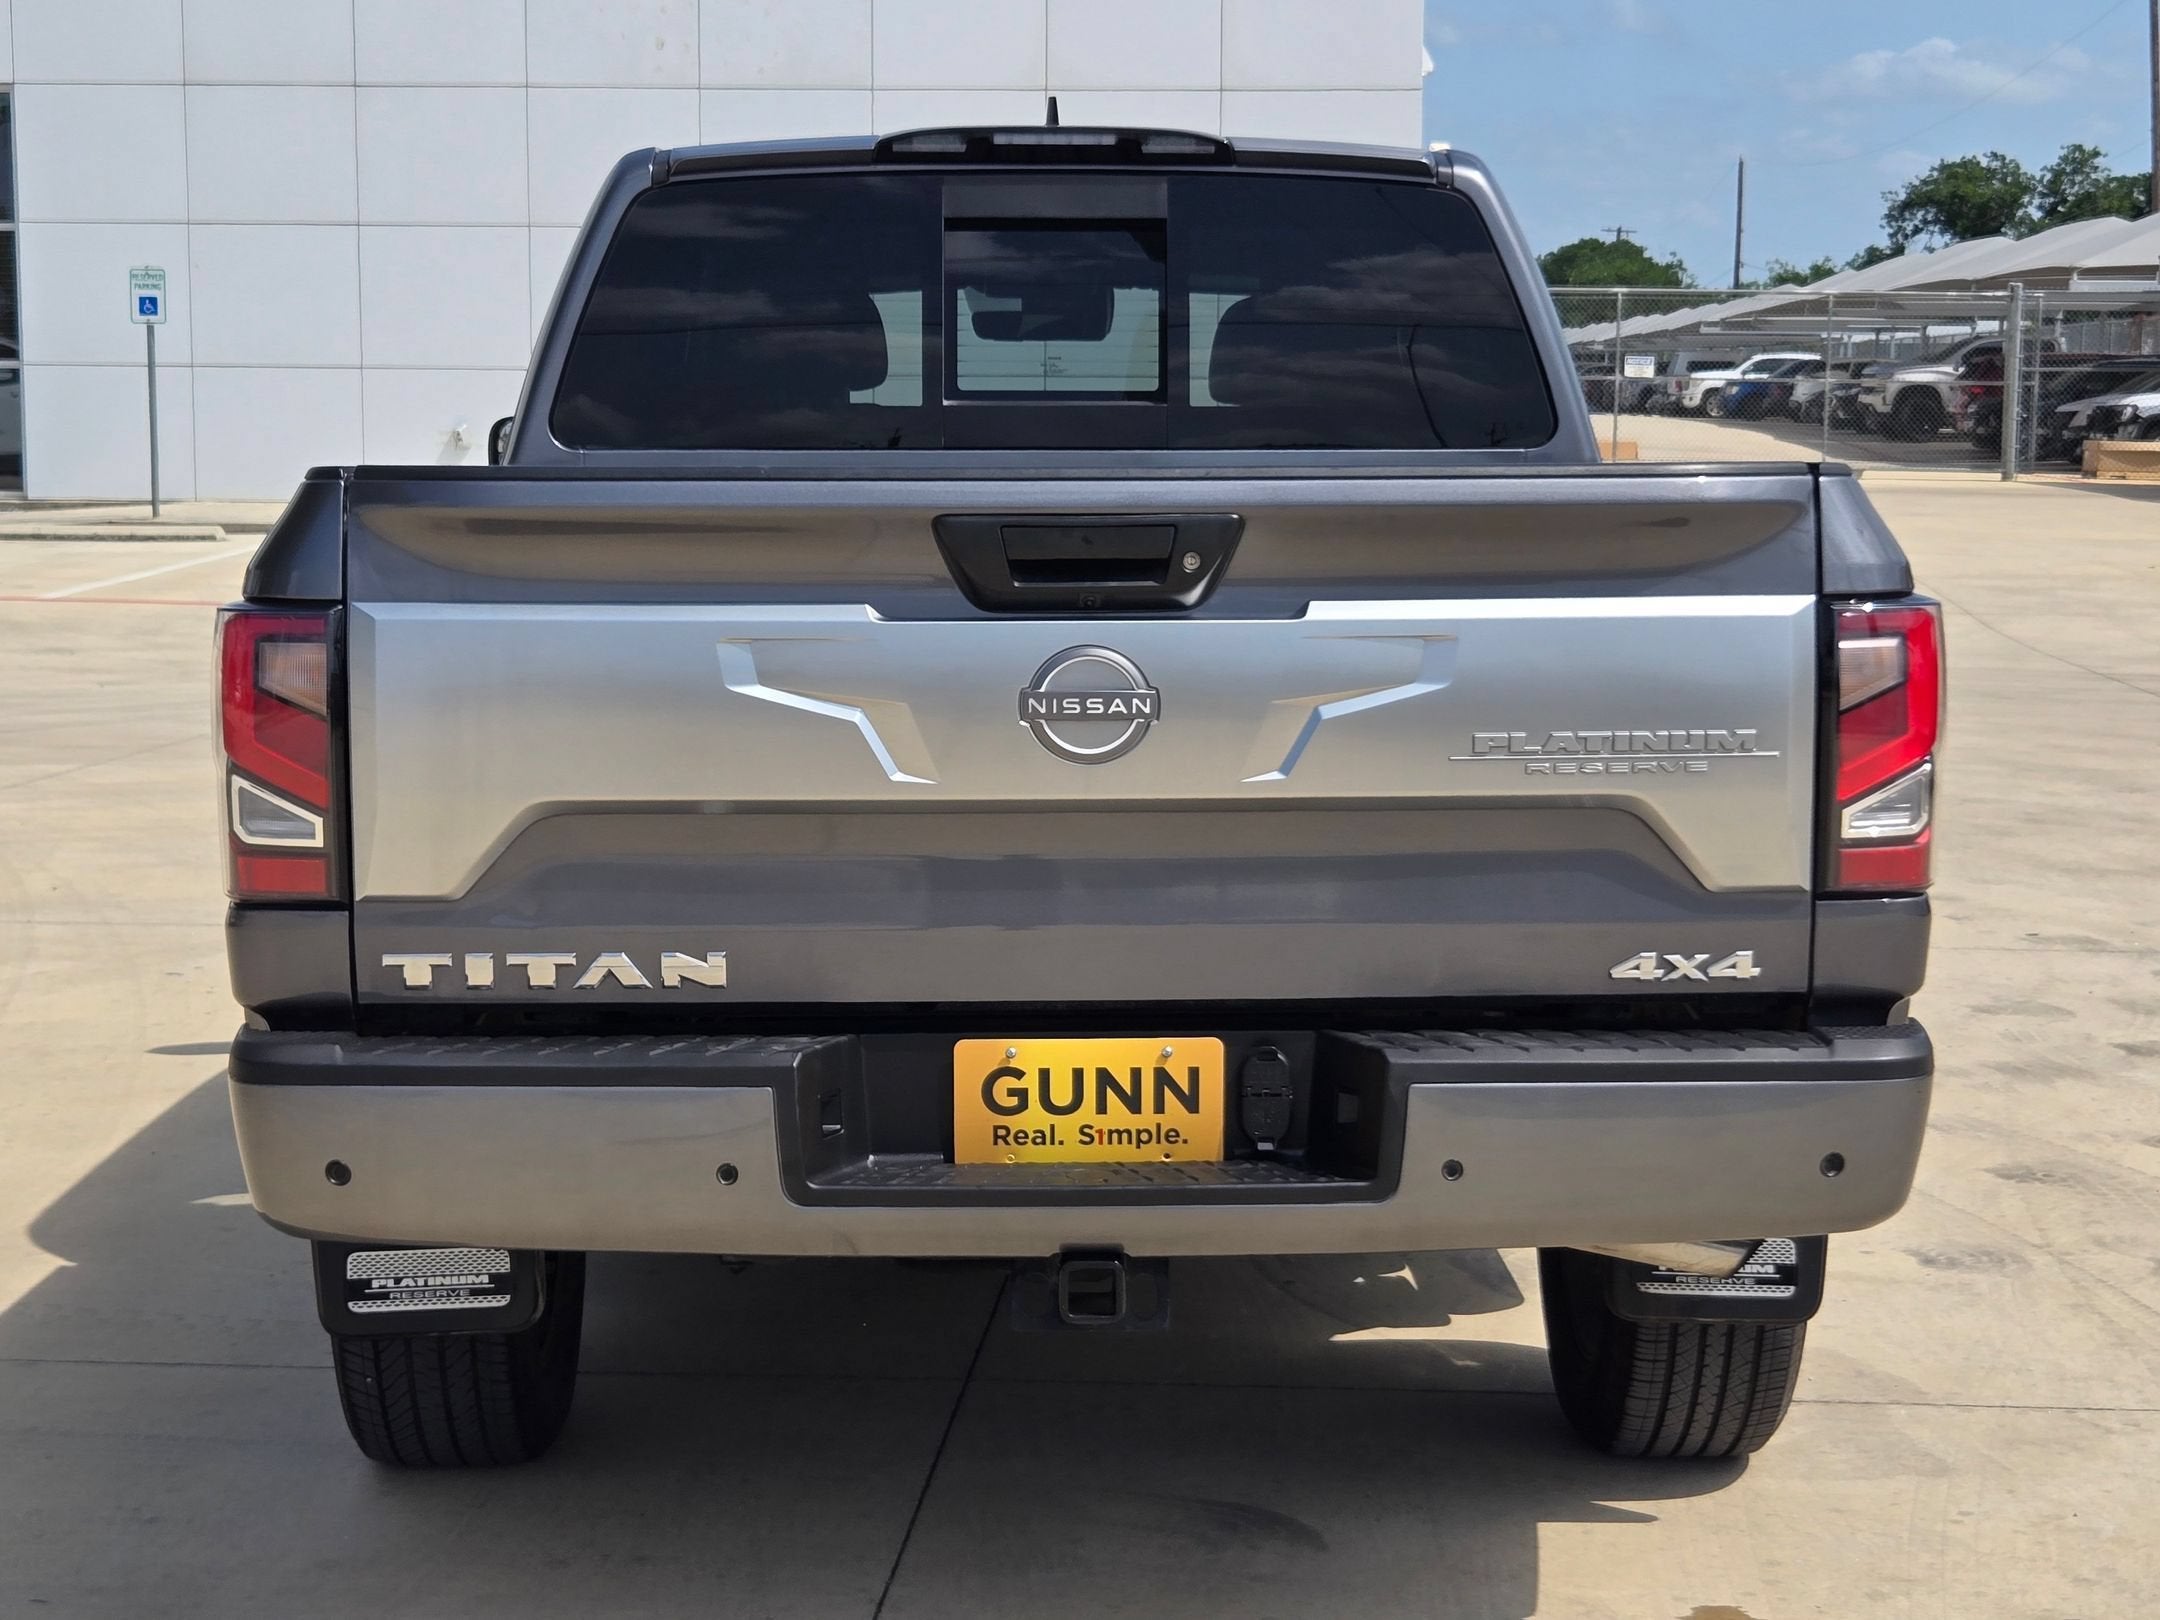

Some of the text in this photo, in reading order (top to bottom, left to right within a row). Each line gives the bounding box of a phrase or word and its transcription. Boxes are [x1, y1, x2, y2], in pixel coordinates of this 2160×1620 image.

[1028, 698, 1150, 714] NISSAN
[1472, 729, 1757, 754] PLATINUM
[1525, 761, 1709, 775] RESERVE
[382, 952, 727, 989] TITAN
[981, 1066, 1200, 1116] GUNN
[992, 1123, 1065, 1146] Real.
[371, 1274, 490, 1288] PLATINUM
[1675, 1276, 1757, 1285] RESERVE
[389, 1289, 471, 1299] RESERVE
